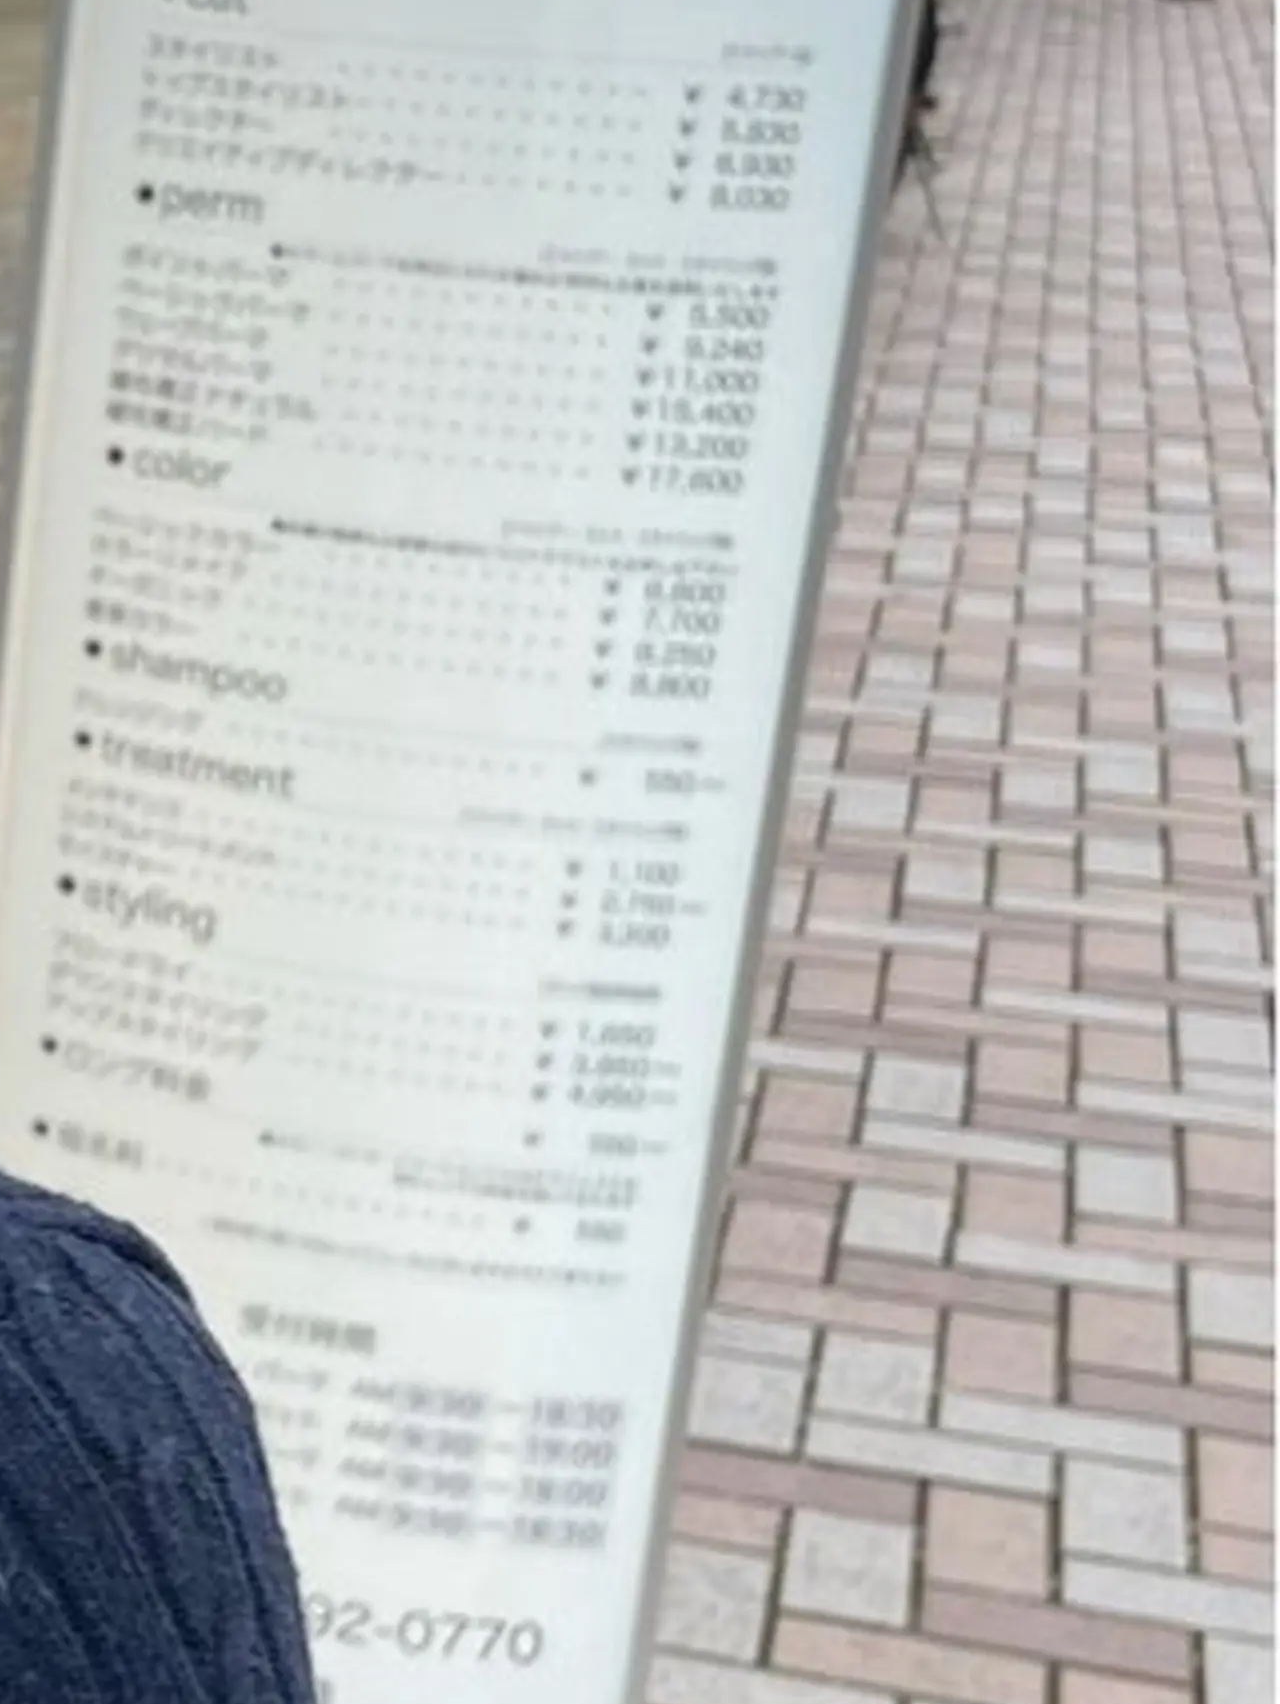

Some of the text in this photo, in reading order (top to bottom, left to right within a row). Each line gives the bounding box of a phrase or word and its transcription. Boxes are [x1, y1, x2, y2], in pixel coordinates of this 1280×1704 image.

[159, 182, 264, 225] perm
[132, 445, 233, 489] color
[110, 636, 288, 704] shampoo
[101, 728, 296, 806] treatment
[83, 878, 219, 947] styling
